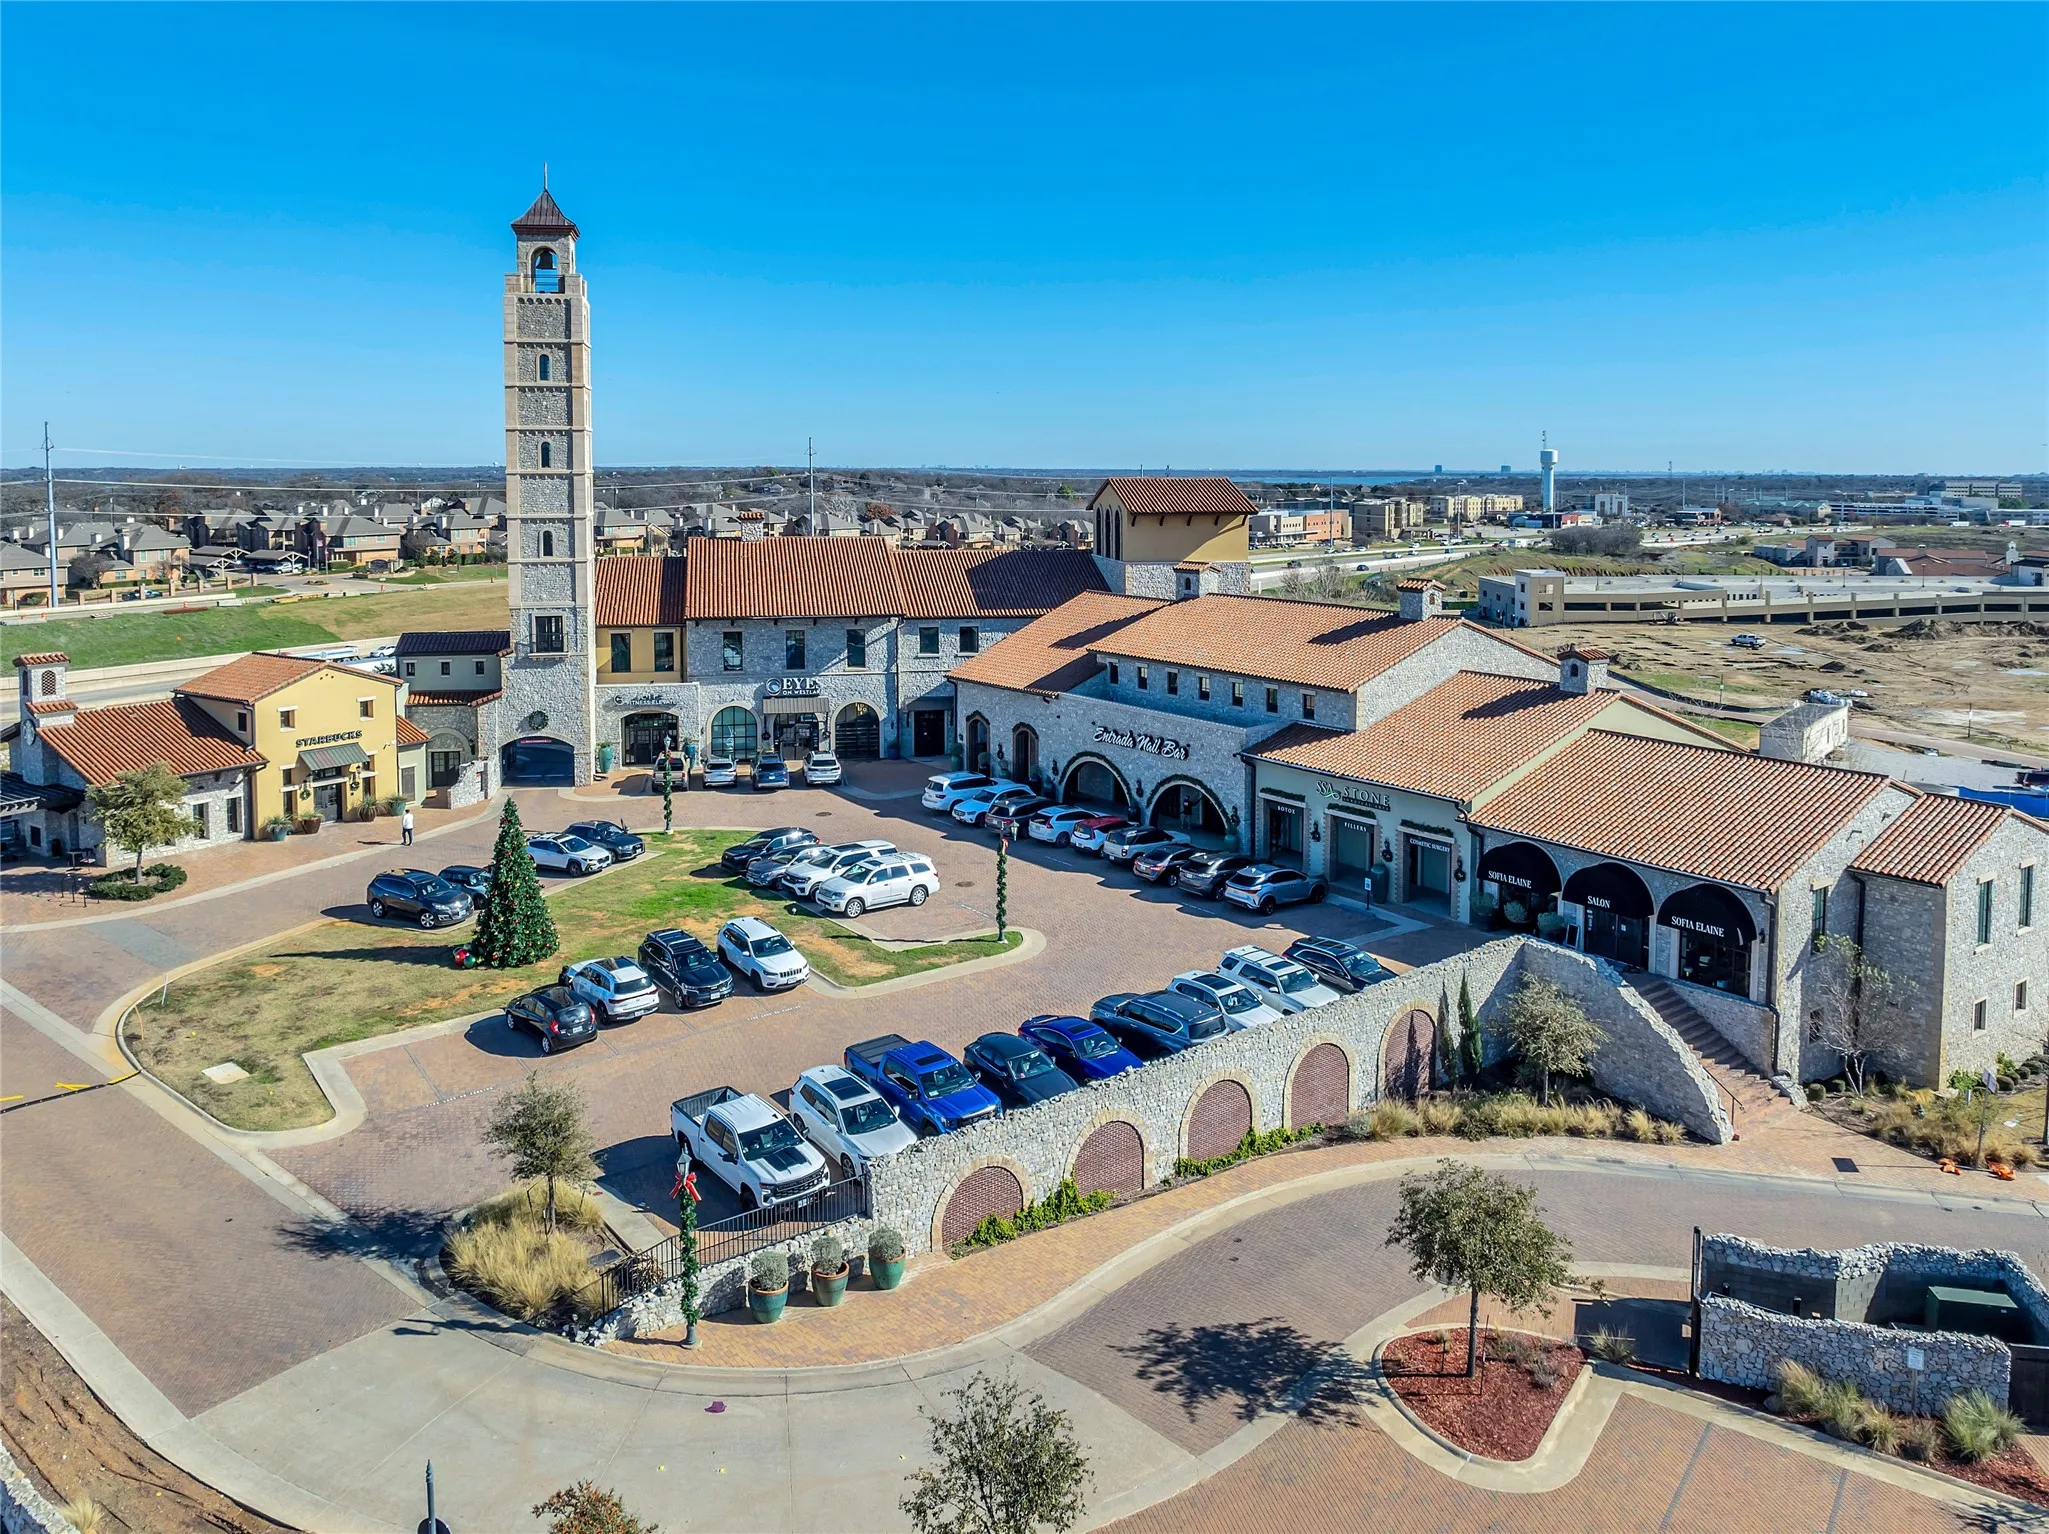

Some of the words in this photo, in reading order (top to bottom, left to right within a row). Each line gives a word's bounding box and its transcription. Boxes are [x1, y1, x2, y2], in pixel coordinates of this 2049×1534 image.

[782, 677, 823, 690] EYES
[295, 730, 363, 748] STARBUCKS
[1093, 727, 1134, 748] Entrada
[1137, 735, 1161, 755] Nail
[1161, 741, 1186, 760] Bar
[1343, 786, 1390, 807] STONE
[1277, 805, 1296, 815] BOTOX
[1344, 822, 1367, 832] FILLERS
[1409, 838, 1431, 849] COSMETIC
[1431, 843, 1450, 853] SURGERY
[1488, 870, 1507, 883] SOFIA
[1508, 875, 1532, 889] ELAINE
[1587, 895, 1611, 909] SALON
[1671, 915, 1695, 930] SOFIA
[1695, 921, 1725, 938] ELAINE
